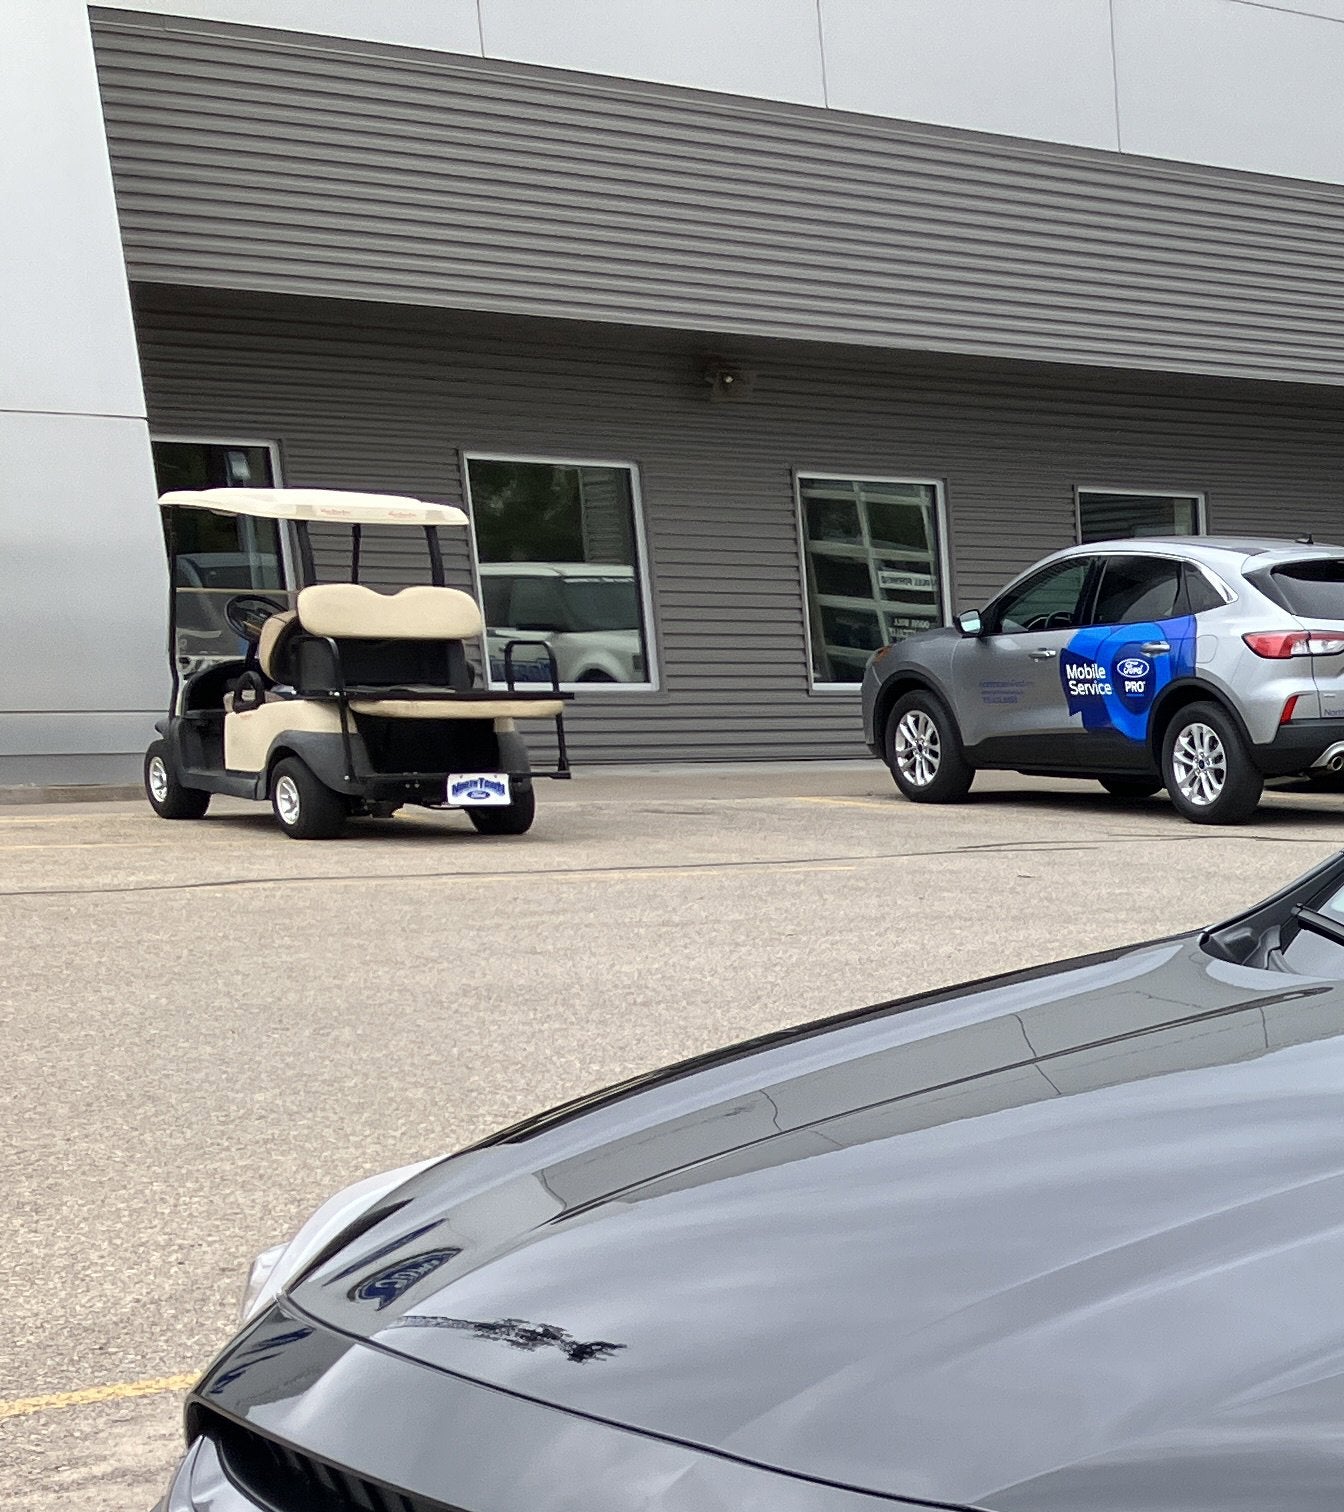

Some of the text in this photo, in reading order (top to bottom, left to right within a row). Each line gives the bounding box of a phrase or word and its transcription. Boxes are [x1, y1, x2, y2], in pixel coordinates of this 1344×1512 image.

[1065, 663, 1107, 679] Mobile
[1122, 661, 1145, 675] Ford
[1068, 680, 1113, 696] Service
[1124, 680, 1146, 693] PRO
